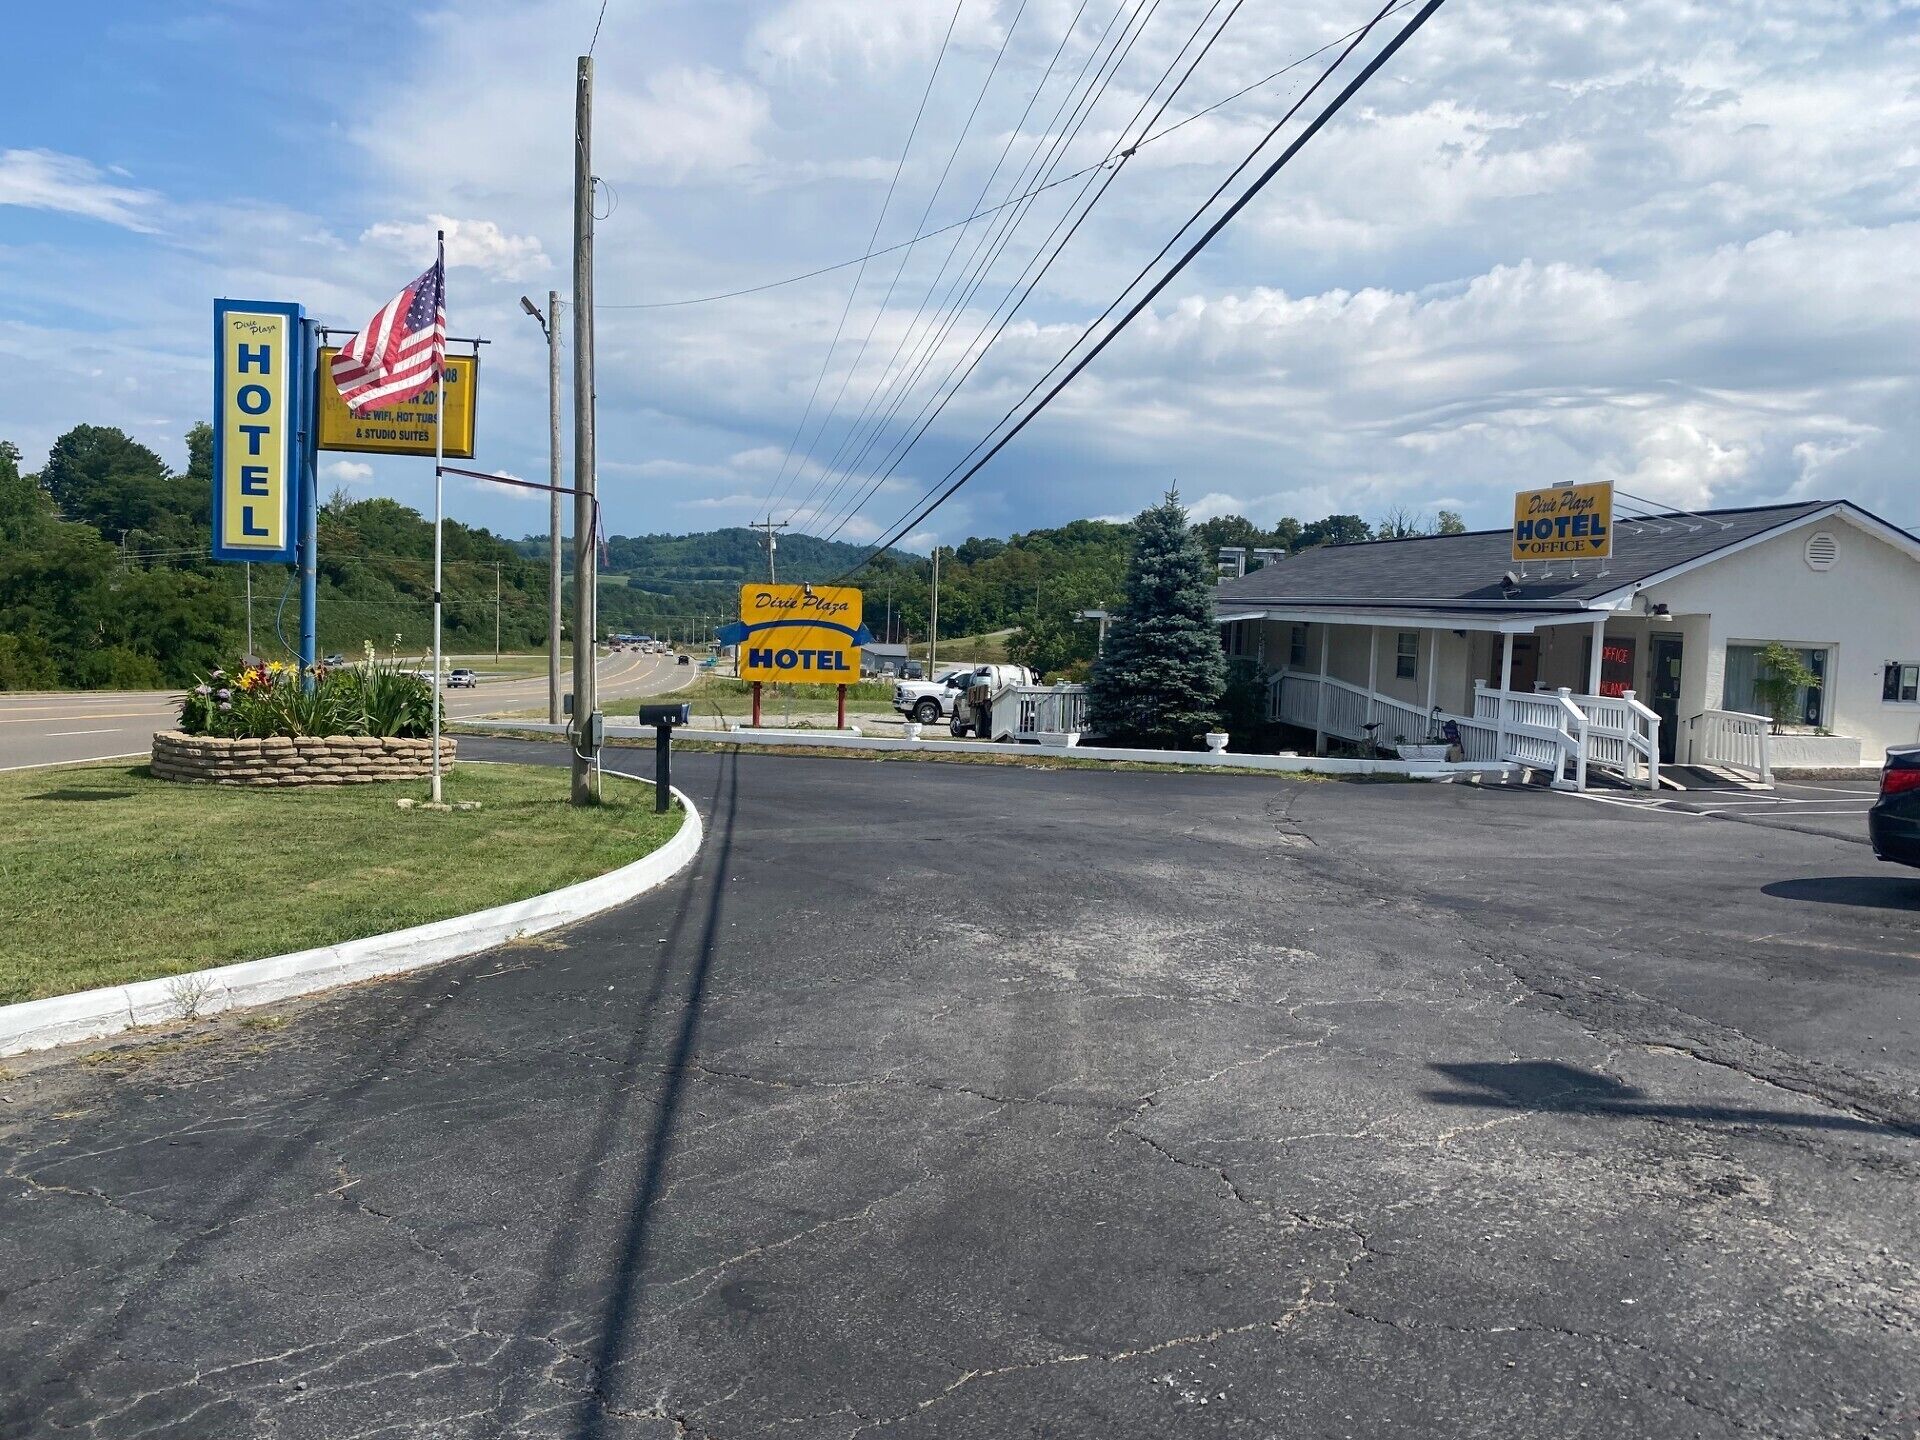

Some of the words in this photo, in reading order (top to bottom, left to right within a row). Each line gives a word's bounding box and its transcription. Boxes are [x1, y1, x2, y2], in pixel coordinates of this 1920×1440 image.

[233, 320, 257, 330] Dixie
[249, 325, 277, 336] Plaza
[422, 390, 448, 405] 207
[373, 410, 394, 423] WIFI,
[396, 411, 415, 422] HOT
[237, 343, 271, 537] HOTEL
[355, 428, 363, 438] &
[364, 428, 397, 440] STUDIO
[398, 430, 430, 442] SUITES
[1528, 494, 1557, 515] Dixie
[1558, 490, 1595, 517] Plaza
[1516, 513, 1607, 541] HOTEL
[1530, 540, 1586, 554] OFFICE
[755, 592, 798, 610] Dixie
[800, 594, 850, 617] Plaza
[749, 647, 851, 671] HOTEL
[1602, 646, 1629, 664] OFFICE
[1600, 680, 1631, 697] ACANCY
